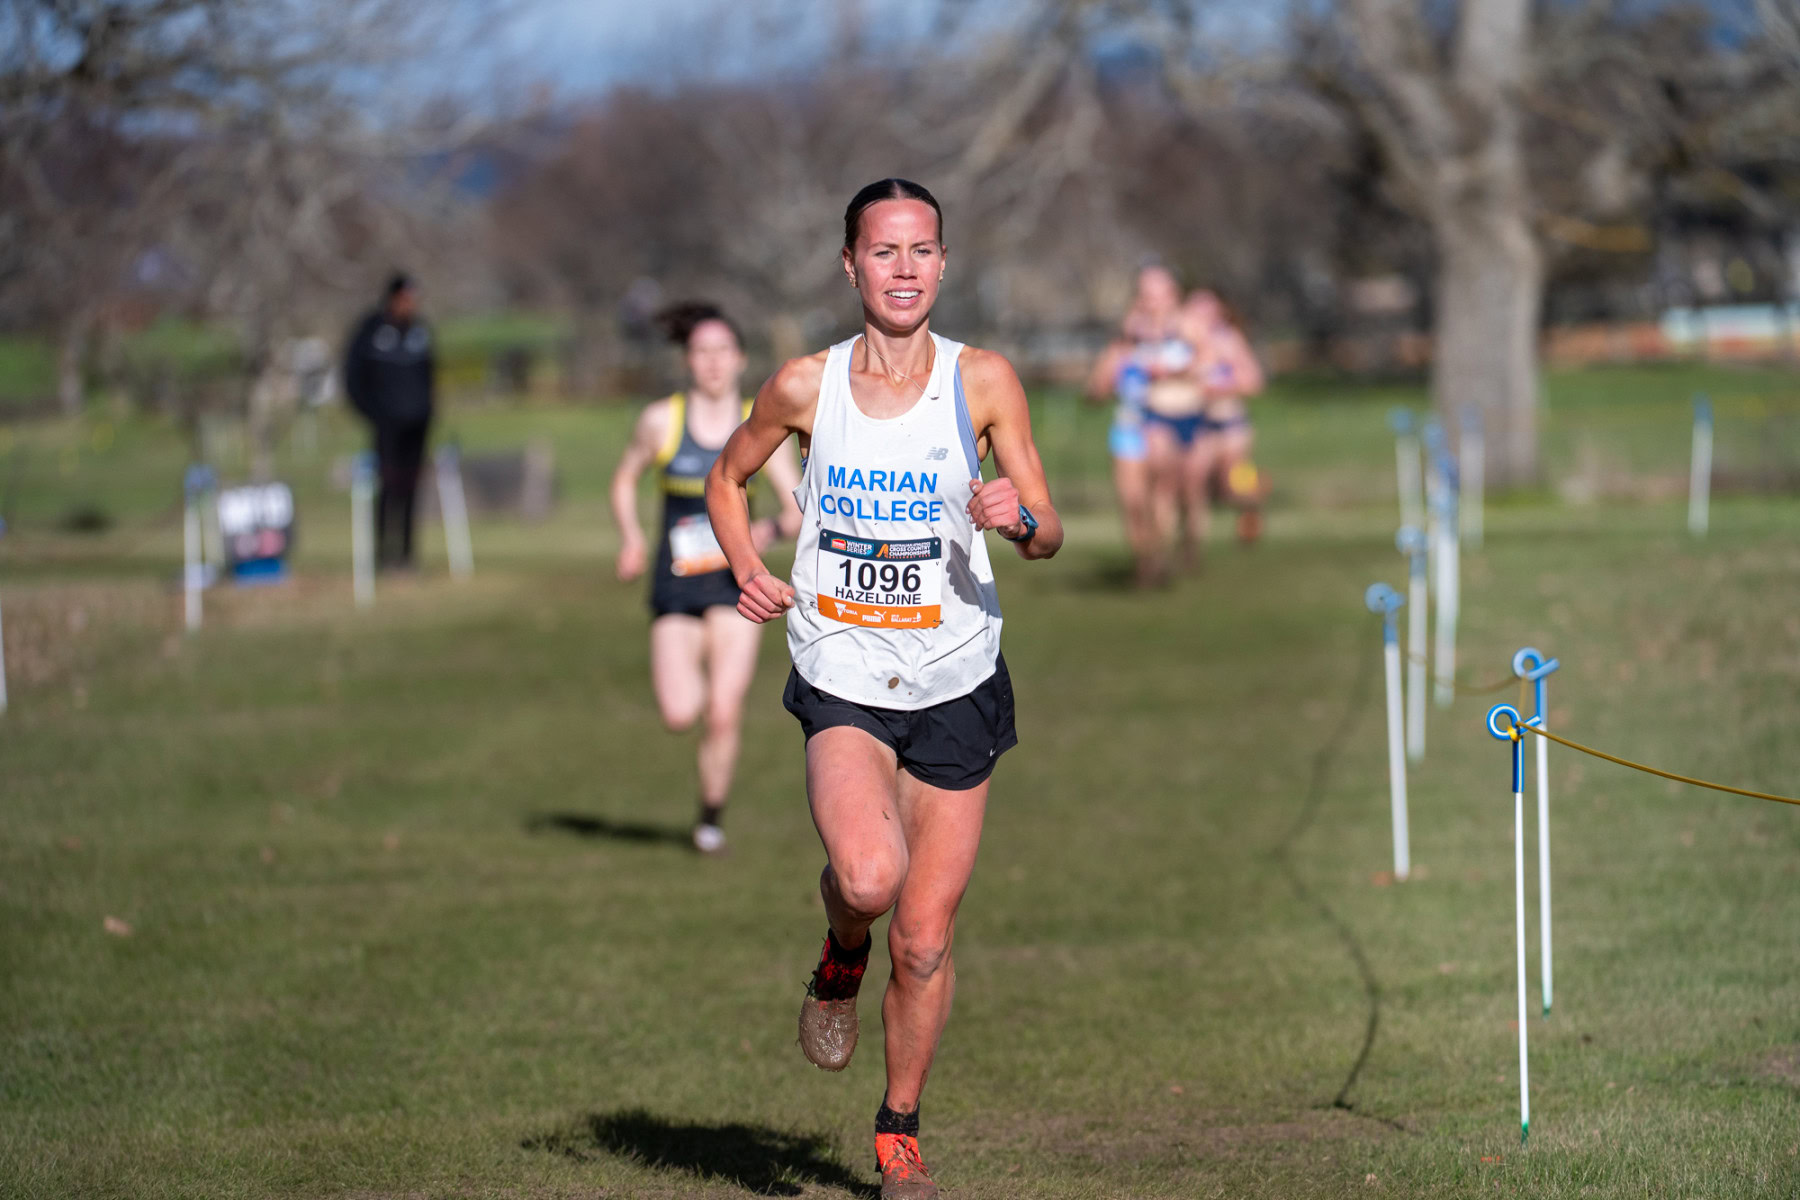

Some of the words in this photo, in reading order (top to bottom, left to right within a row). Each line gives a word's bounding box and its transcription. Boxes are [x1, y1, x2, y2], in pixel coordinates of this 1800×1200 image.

[828, 465, 938, 494] MARIAN
[820, 494, 943, 522] COLLEGE
[847, 540, 873, 551] WINTER
[847, 547, 868, 555] SERIES
[840, 559, 921, 592] 1096
[835, 586, 922, 605] HAZELDINE
